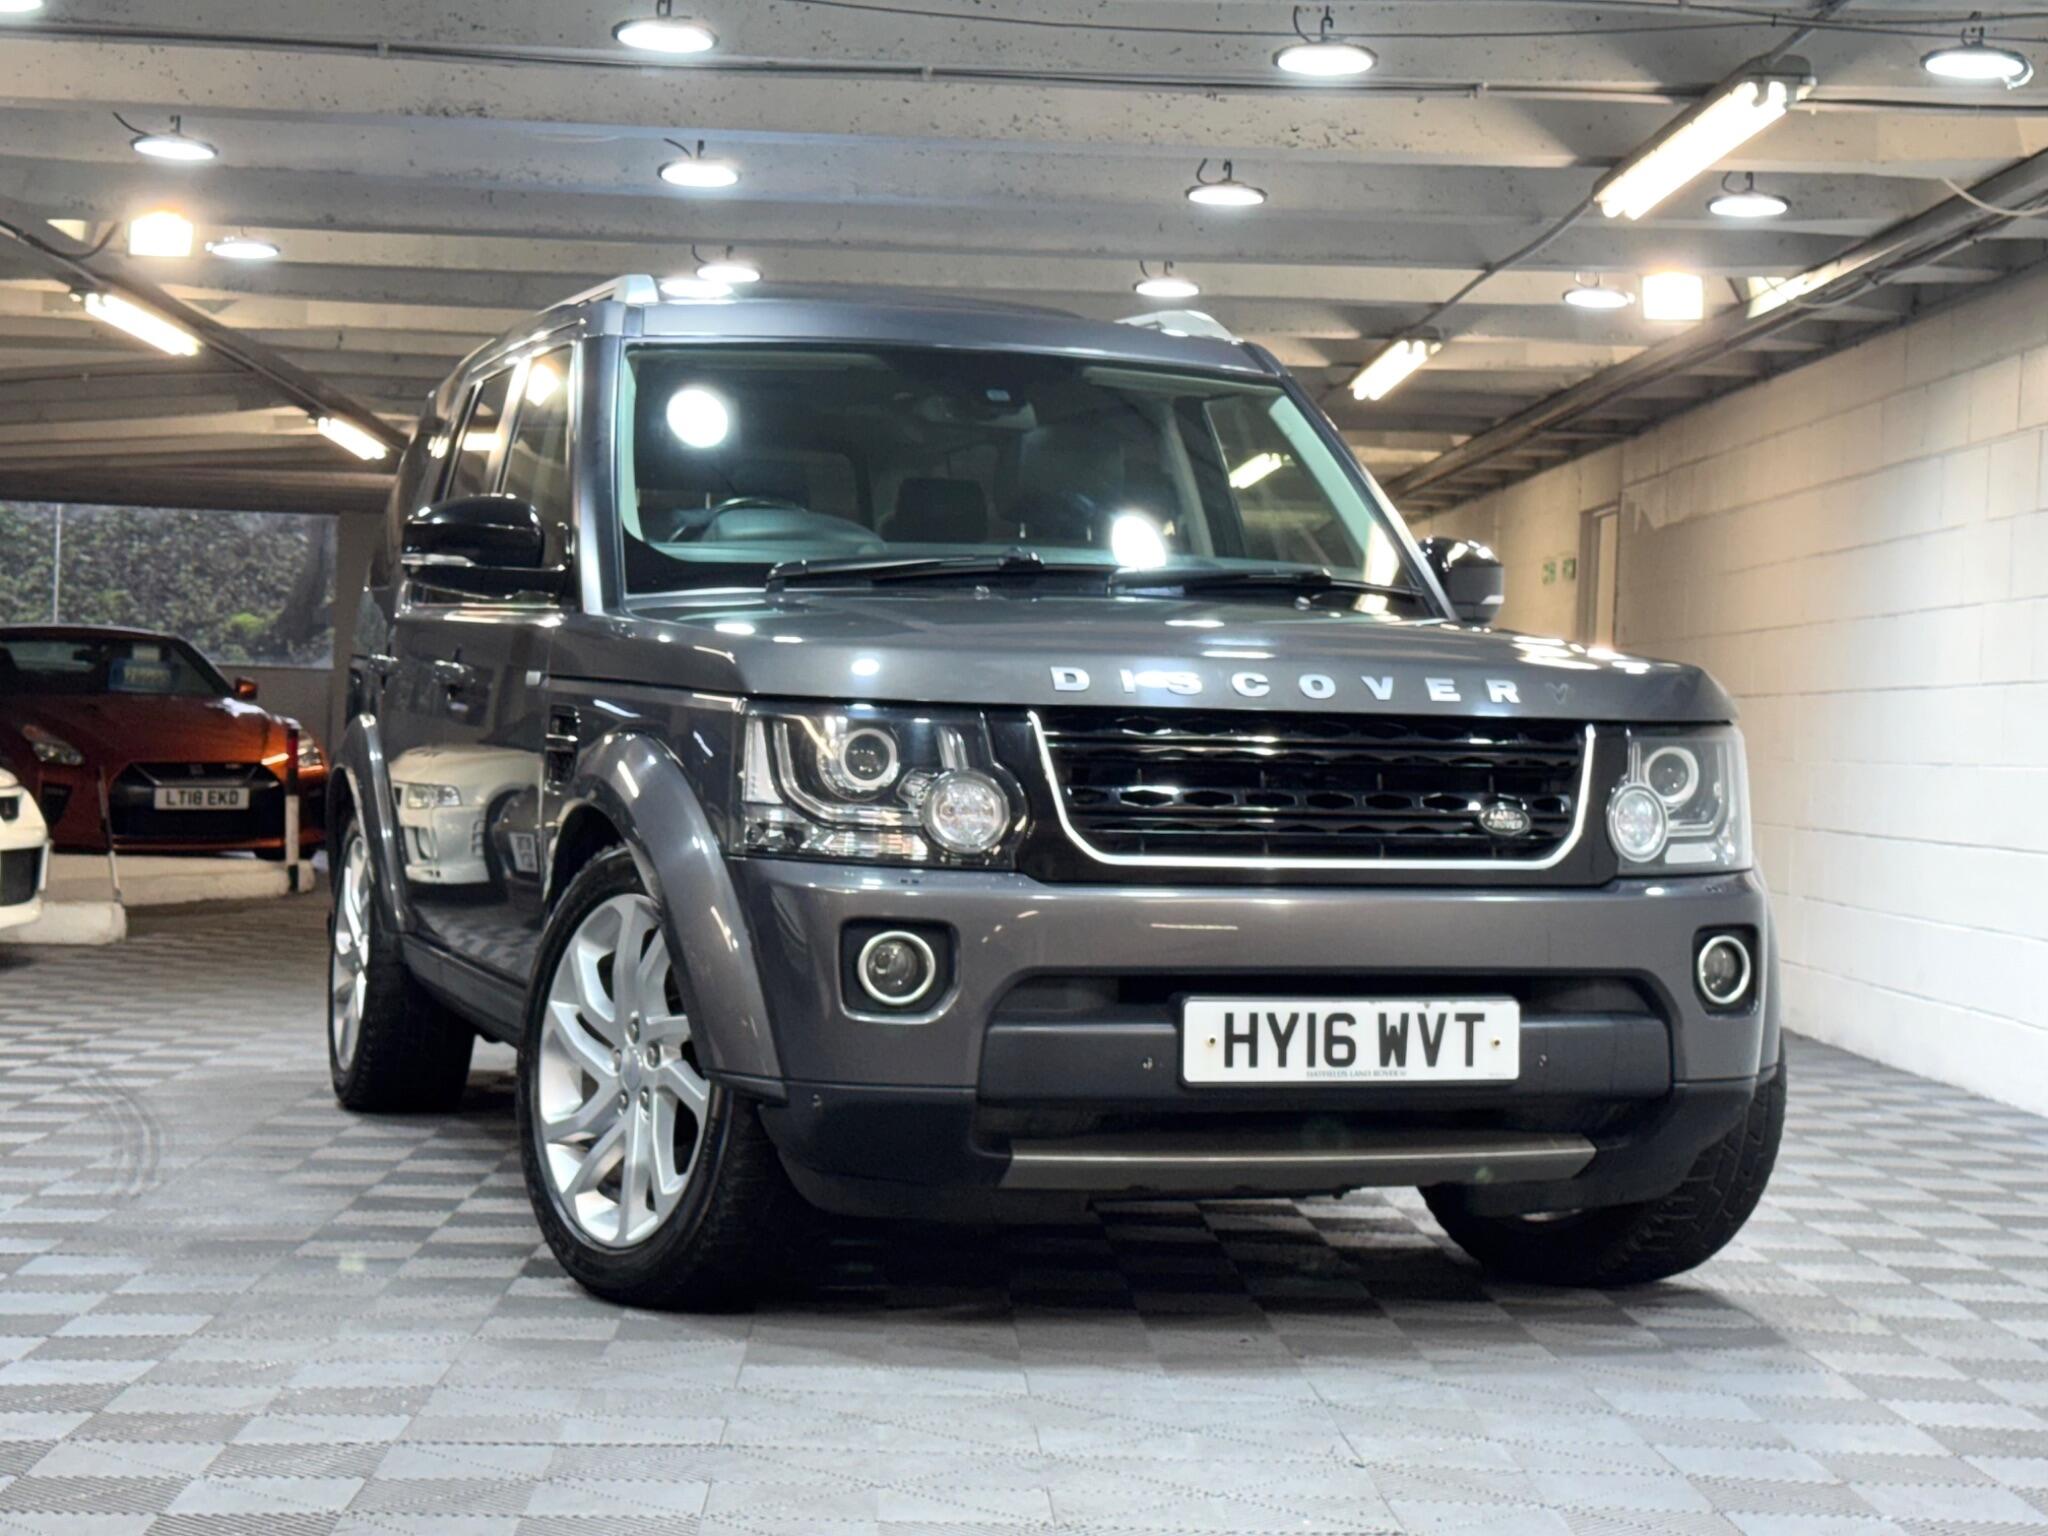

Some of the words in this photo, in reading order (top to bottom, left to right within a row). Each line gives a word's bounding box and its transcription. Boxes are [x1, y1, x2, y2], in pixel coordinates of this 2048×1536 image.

[165, 789, 203, 807] LT18
[1489, 810, 1516, 820] LAND
[1492, 820, 1523, 830] ROVER
[1223, 1012, 1357, 1069] HY16
[1377, 1012, 1486, 1069] WVT
